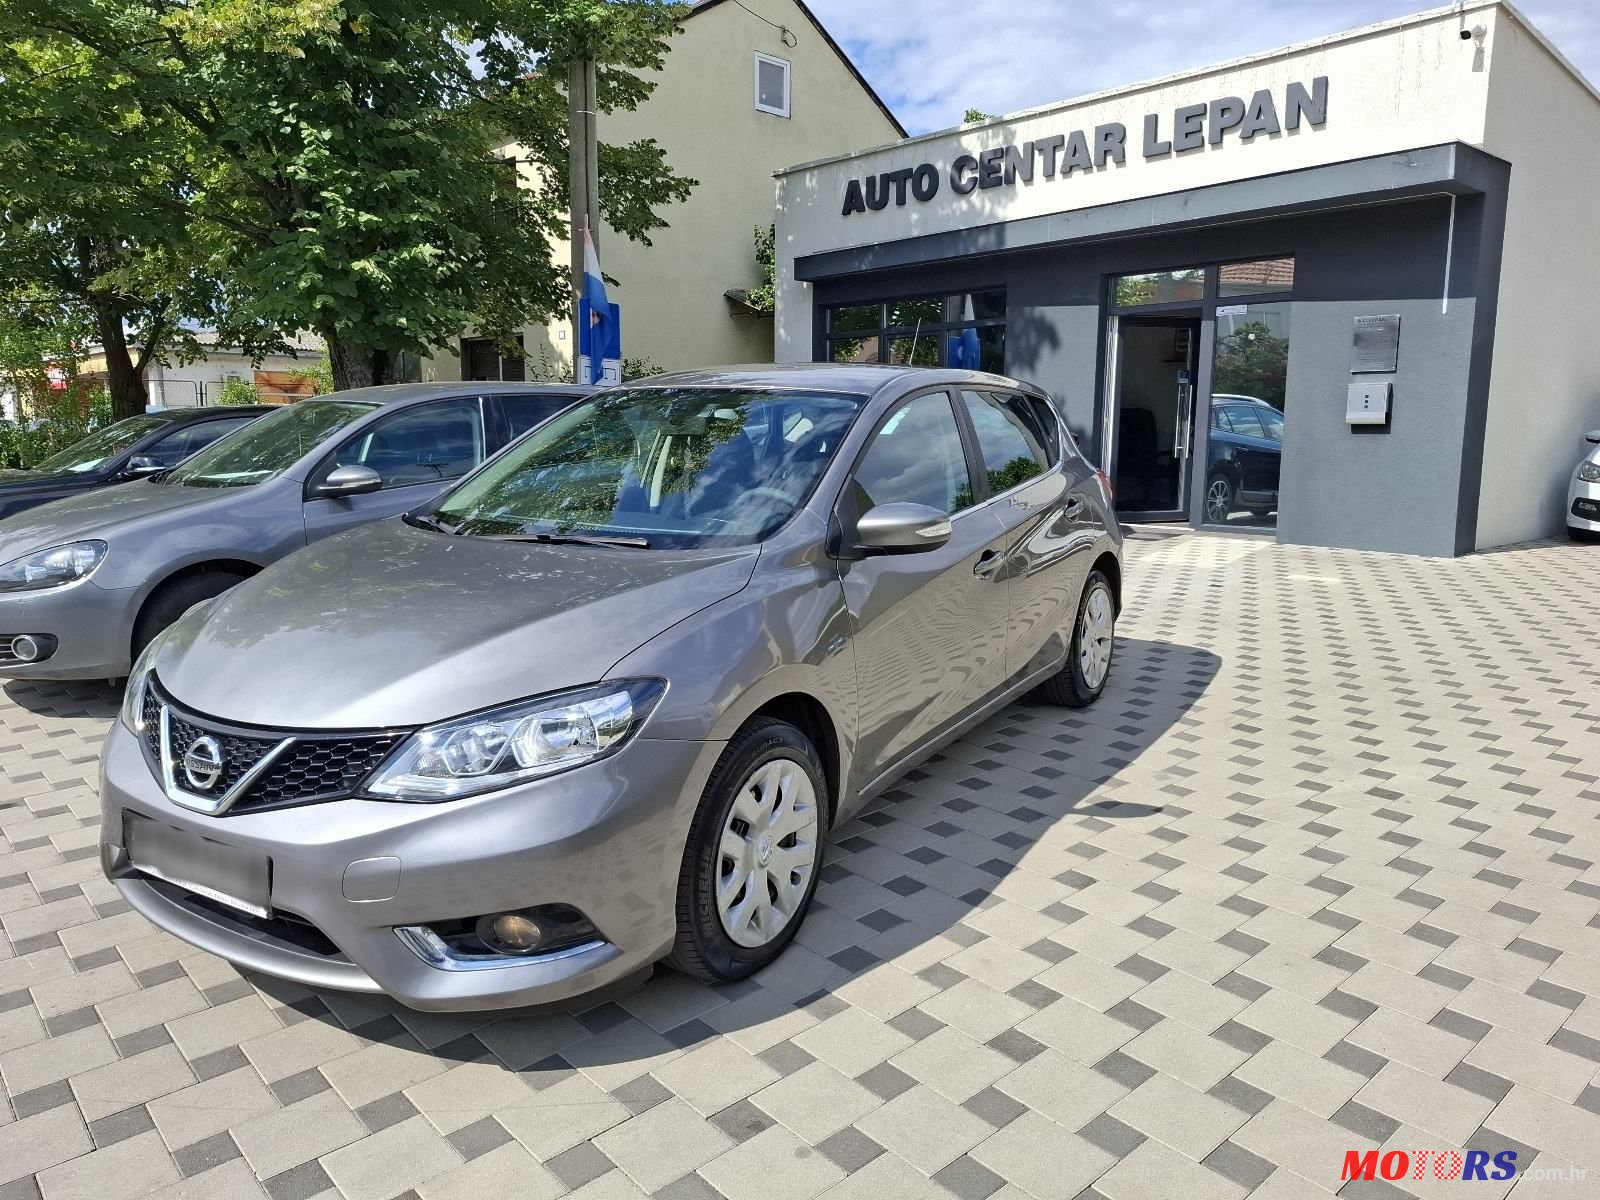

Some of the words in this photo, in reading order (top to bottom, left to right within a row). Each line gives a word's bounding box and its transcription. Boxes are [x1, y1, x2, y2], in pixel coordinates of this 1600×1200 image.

[842, 164, 939, 216] AUTO
[950, 122, 1126, 195] CENTAR
[1142, 76, 1329, 158] LEPAN
[185, 757, 215, 772] NISSAN
